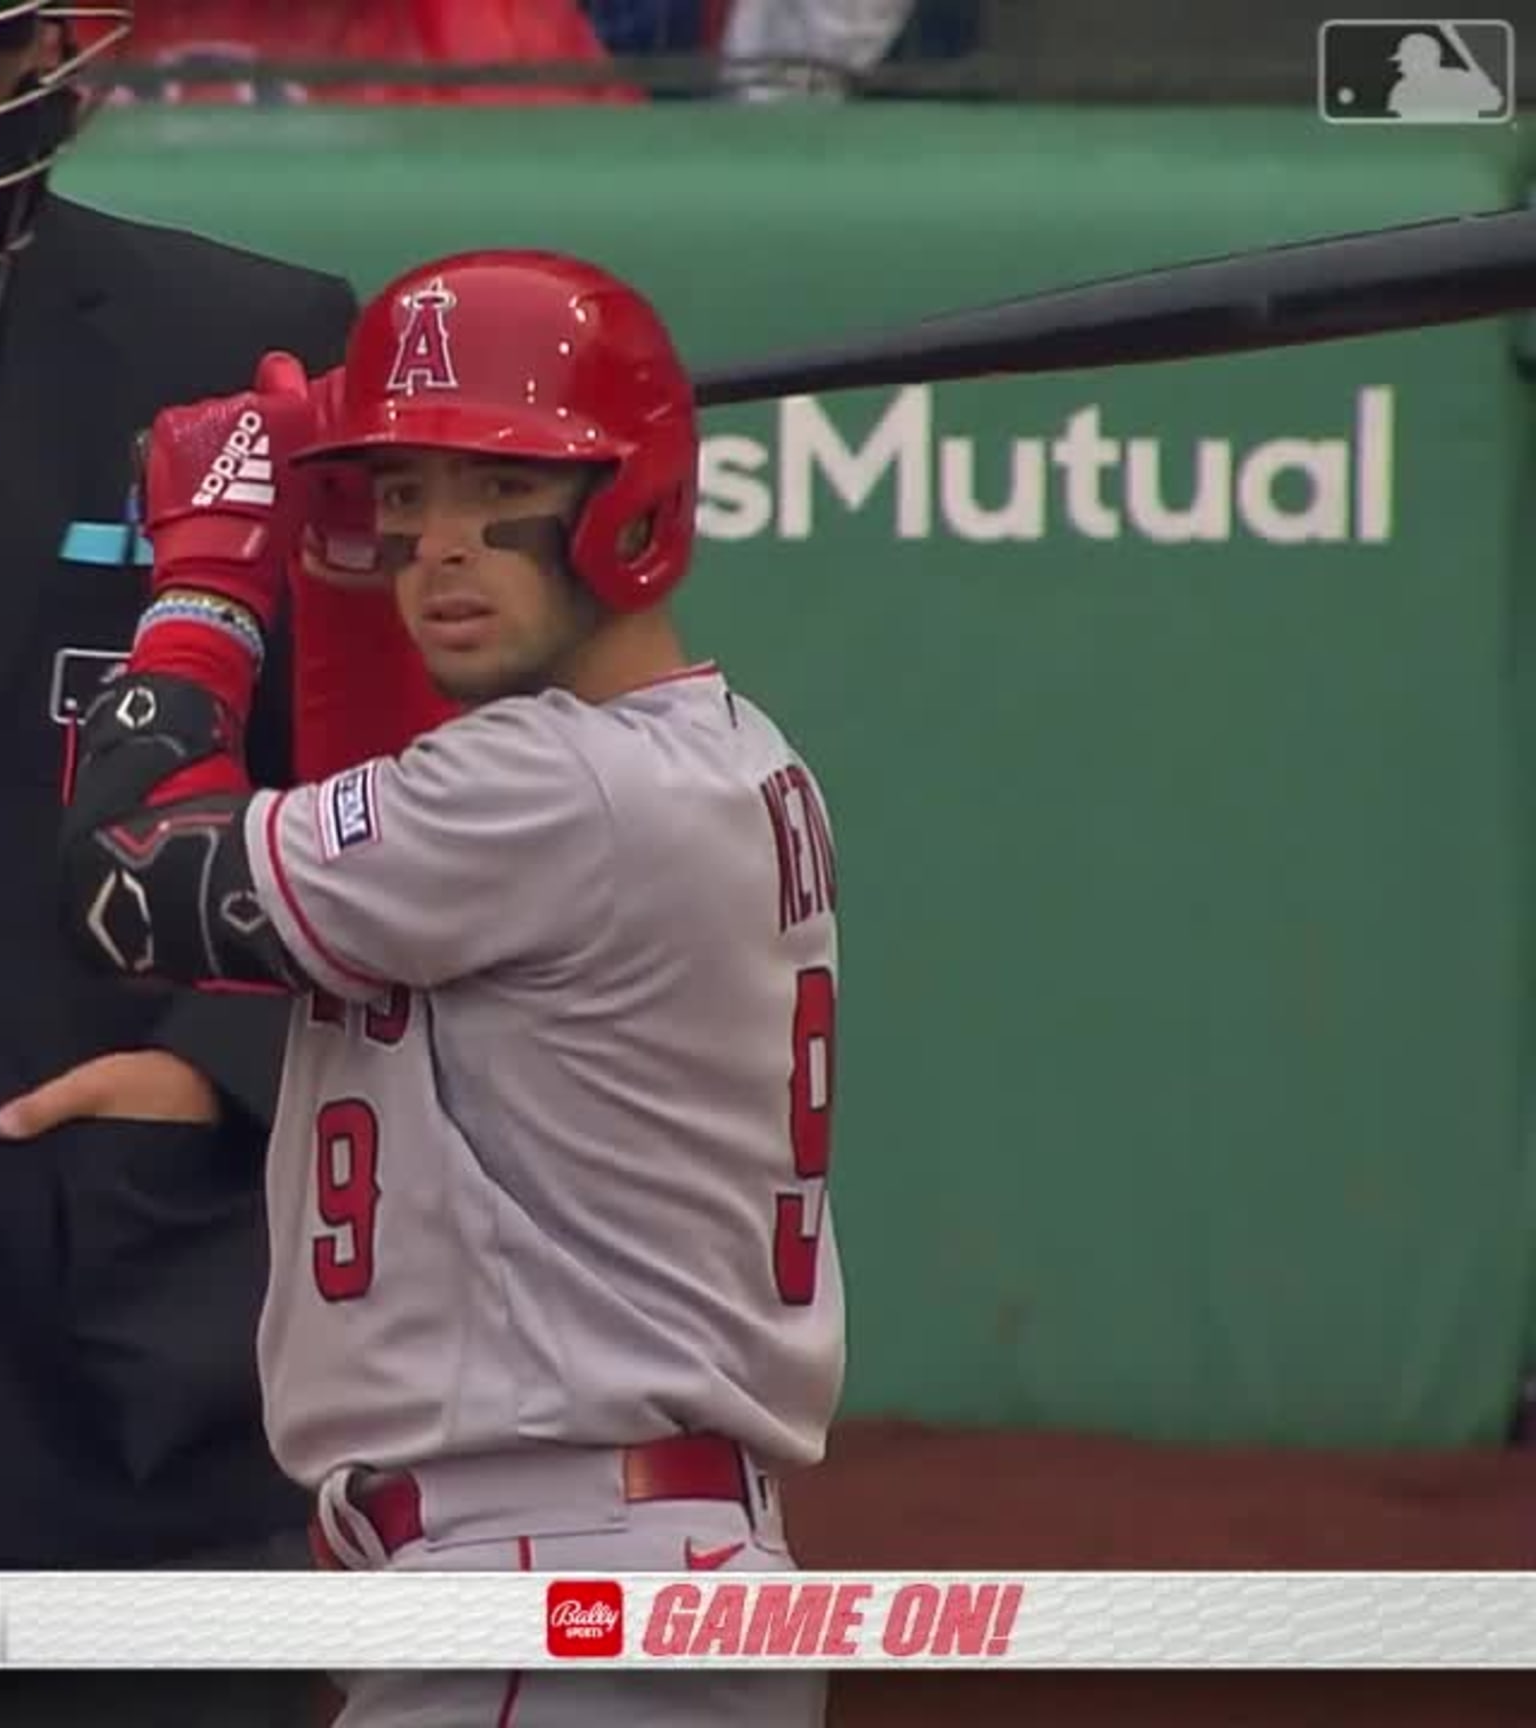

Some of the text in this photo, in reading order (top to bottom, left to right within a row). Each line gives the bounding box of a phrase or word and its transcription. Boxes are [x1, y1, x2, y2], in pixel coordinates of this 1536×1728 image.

[191, 410, 262, 506] adidas
[313, 1097, 381, 1302] 9
[773, 966, 836, 1306] 9
